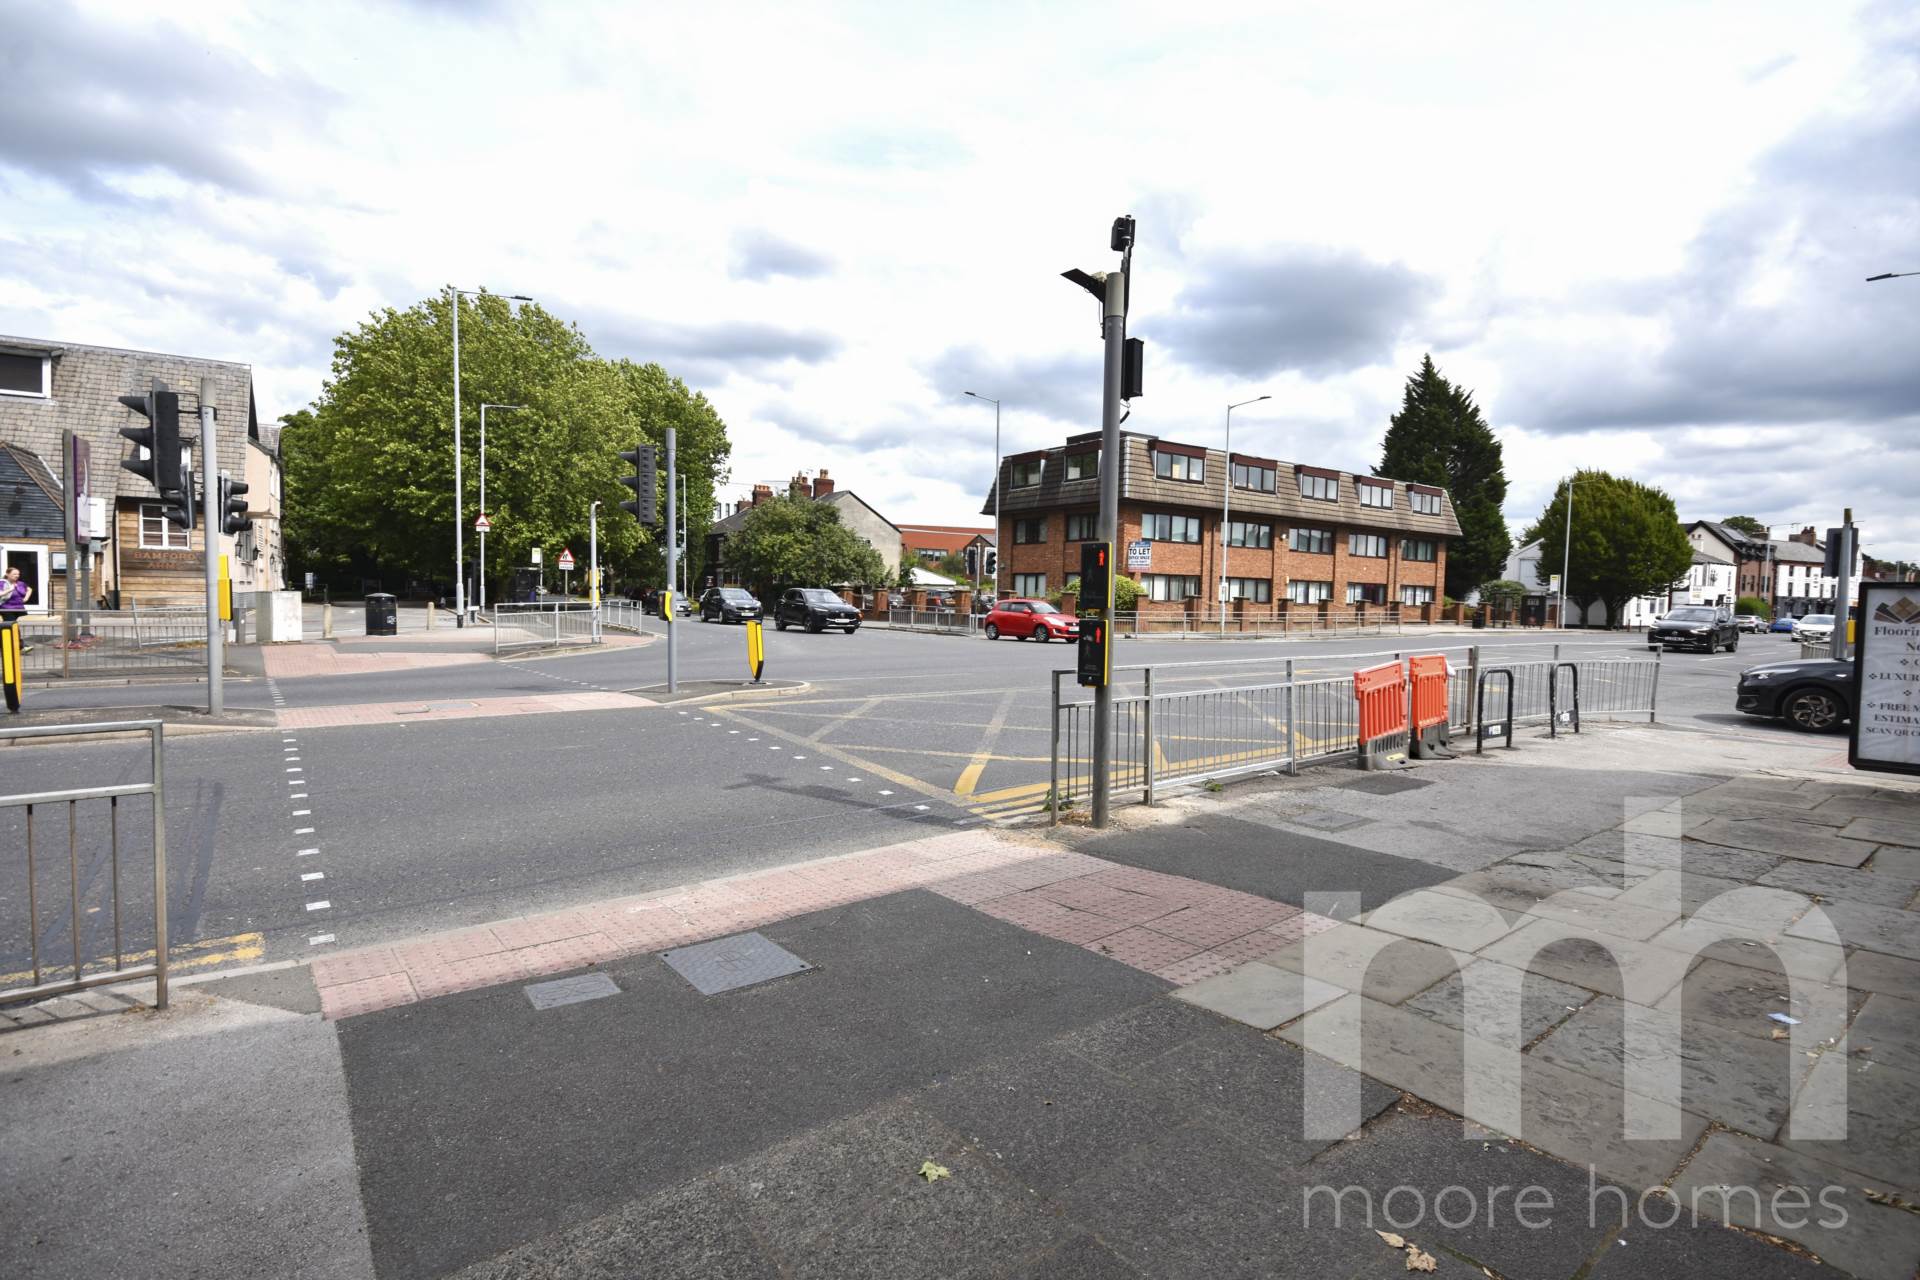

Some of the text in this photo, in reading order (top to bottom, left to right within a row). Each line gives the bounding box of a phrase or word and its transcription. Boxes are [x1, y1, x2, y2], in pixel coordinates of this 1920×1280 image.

[133, 552, 196, 560] BAMFORD
[1880, 703, 1912, 712] FREE
[1874, 714, 1920, 724] ESTIMA
[1865, 726, 1892, 735] SCAN
[1894, 729, 1909, 737] QR
